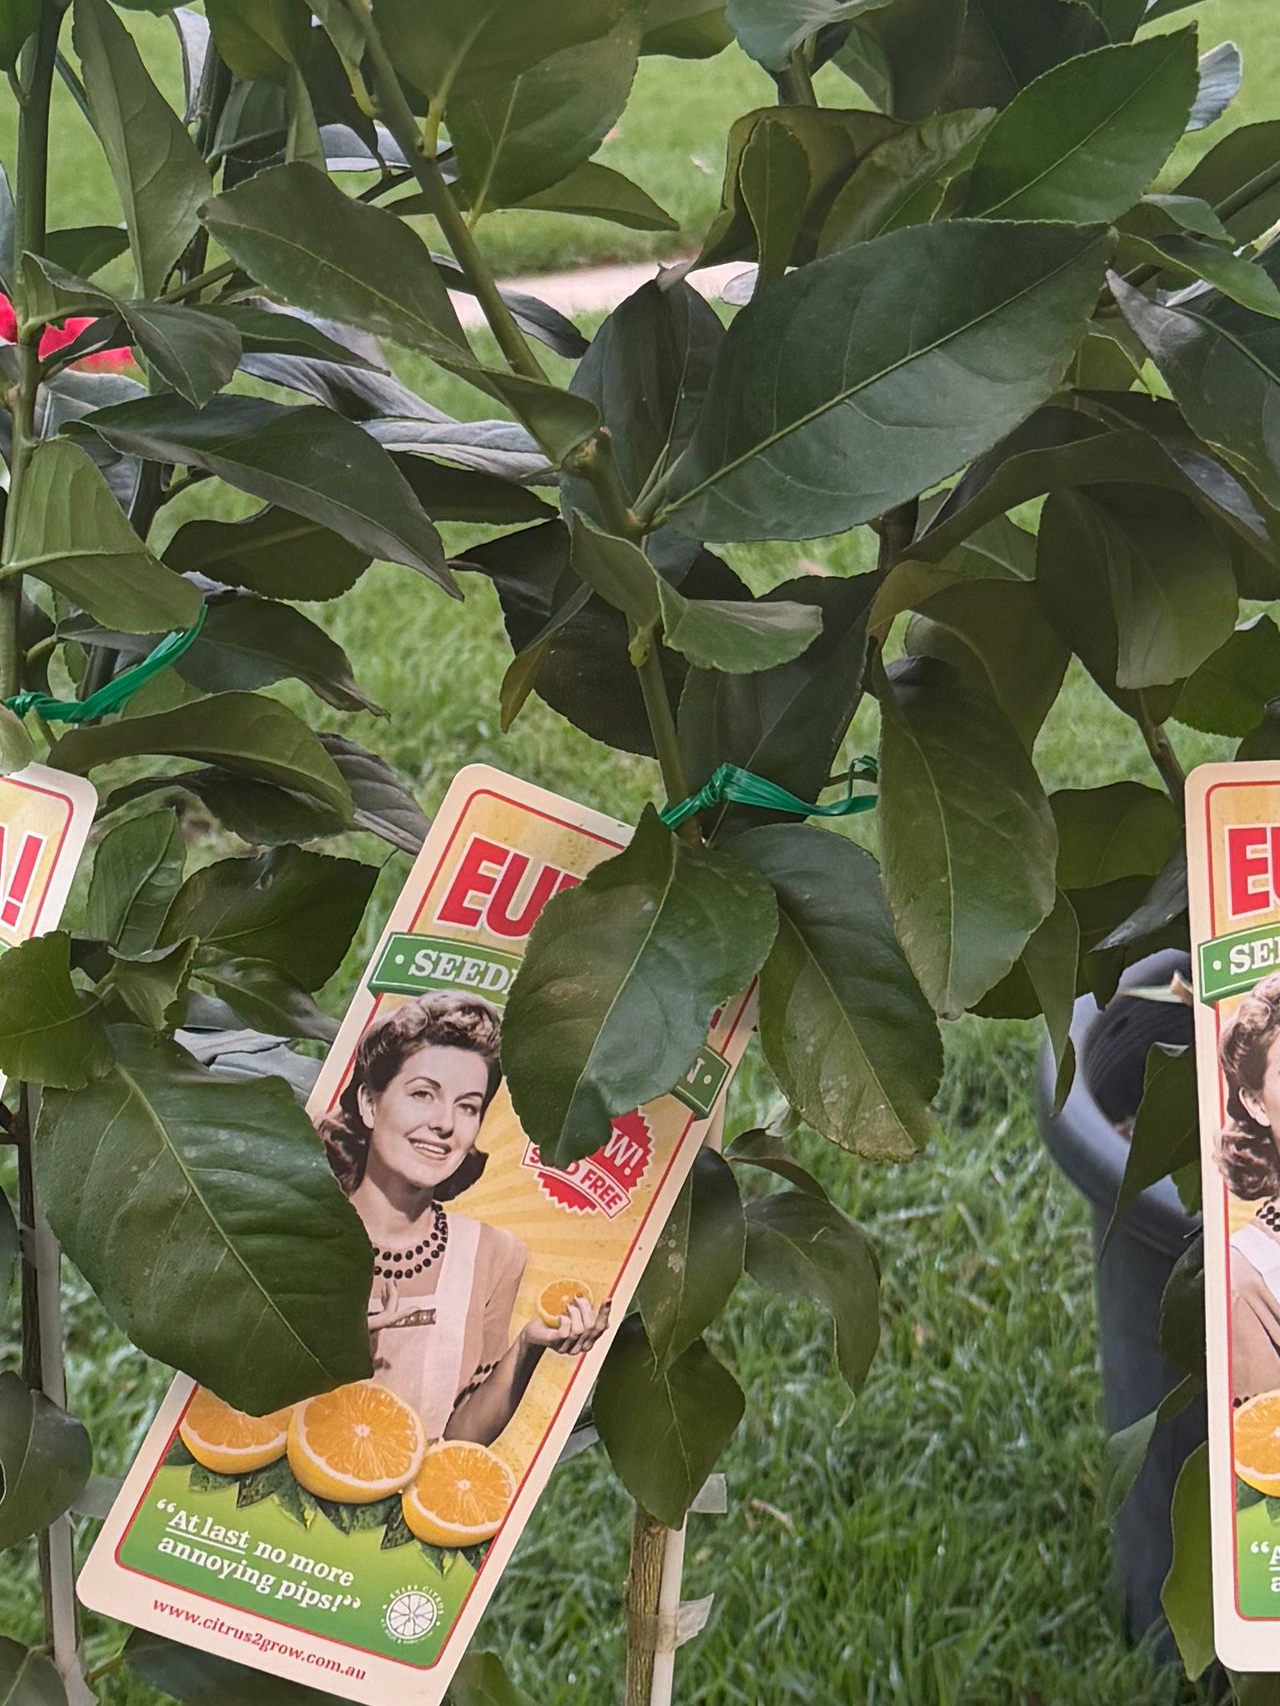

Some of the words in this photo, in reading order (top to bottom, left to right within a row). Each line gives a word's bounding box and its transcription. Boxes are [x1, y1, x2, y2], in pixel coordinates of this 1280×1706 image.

[580, 1167, 623, 1211] FREE
[157, 1537, 277, 1595] annoying
[201, 1516, 252, 1550] last
[253, 1541, 286, 1565] no
[288, 1553, 355, 1588] more
[152, 1598, 367, 1682] www.citrus2grow.com.au
